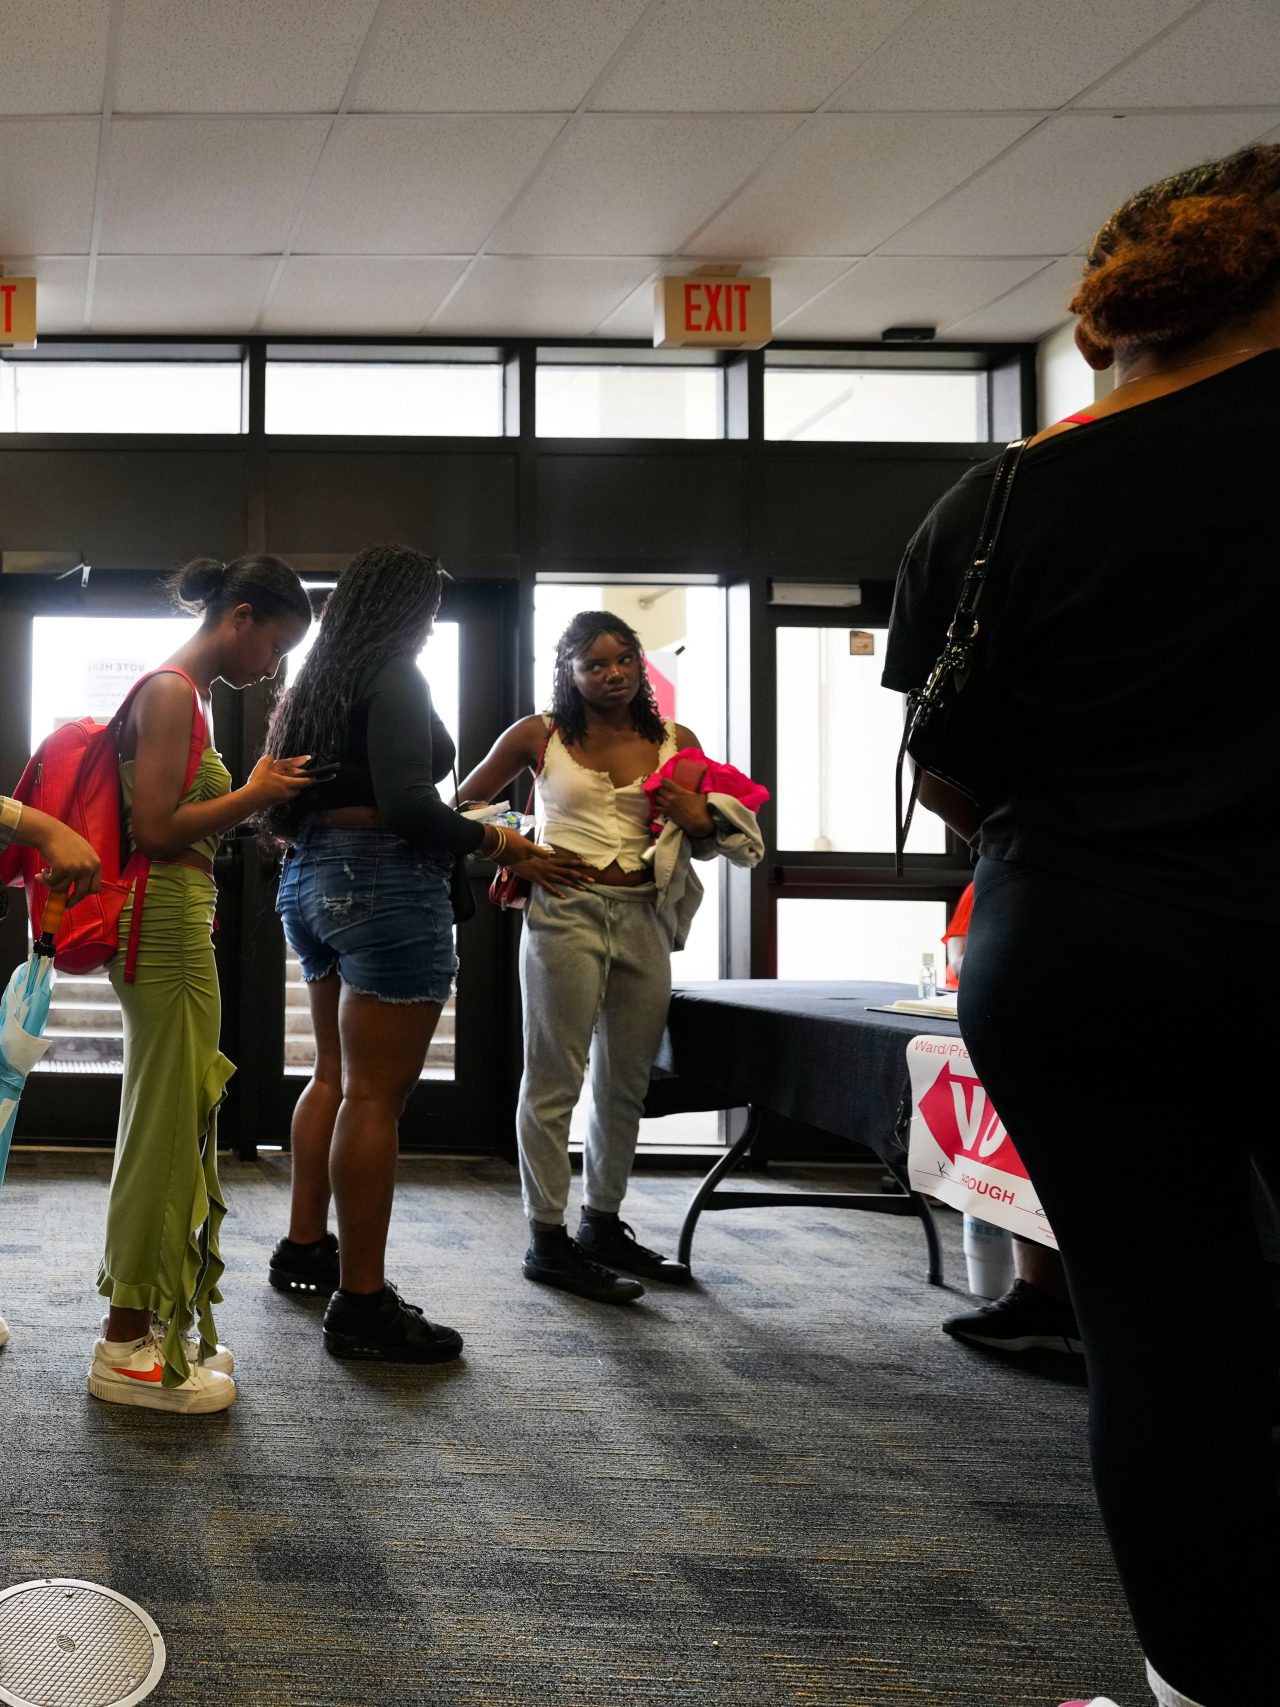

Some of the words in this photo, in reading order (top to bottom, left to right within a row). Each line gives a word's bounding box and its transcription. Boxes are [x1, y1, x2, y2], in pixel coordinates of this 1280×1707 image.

[684, 284, 751, 332] EXIT
[914, 1040, 970, 1059] Ward/Pre
[949, 1081, 1008, 1158] VO
[962, 1173, 1016, 1205] ROUGH
